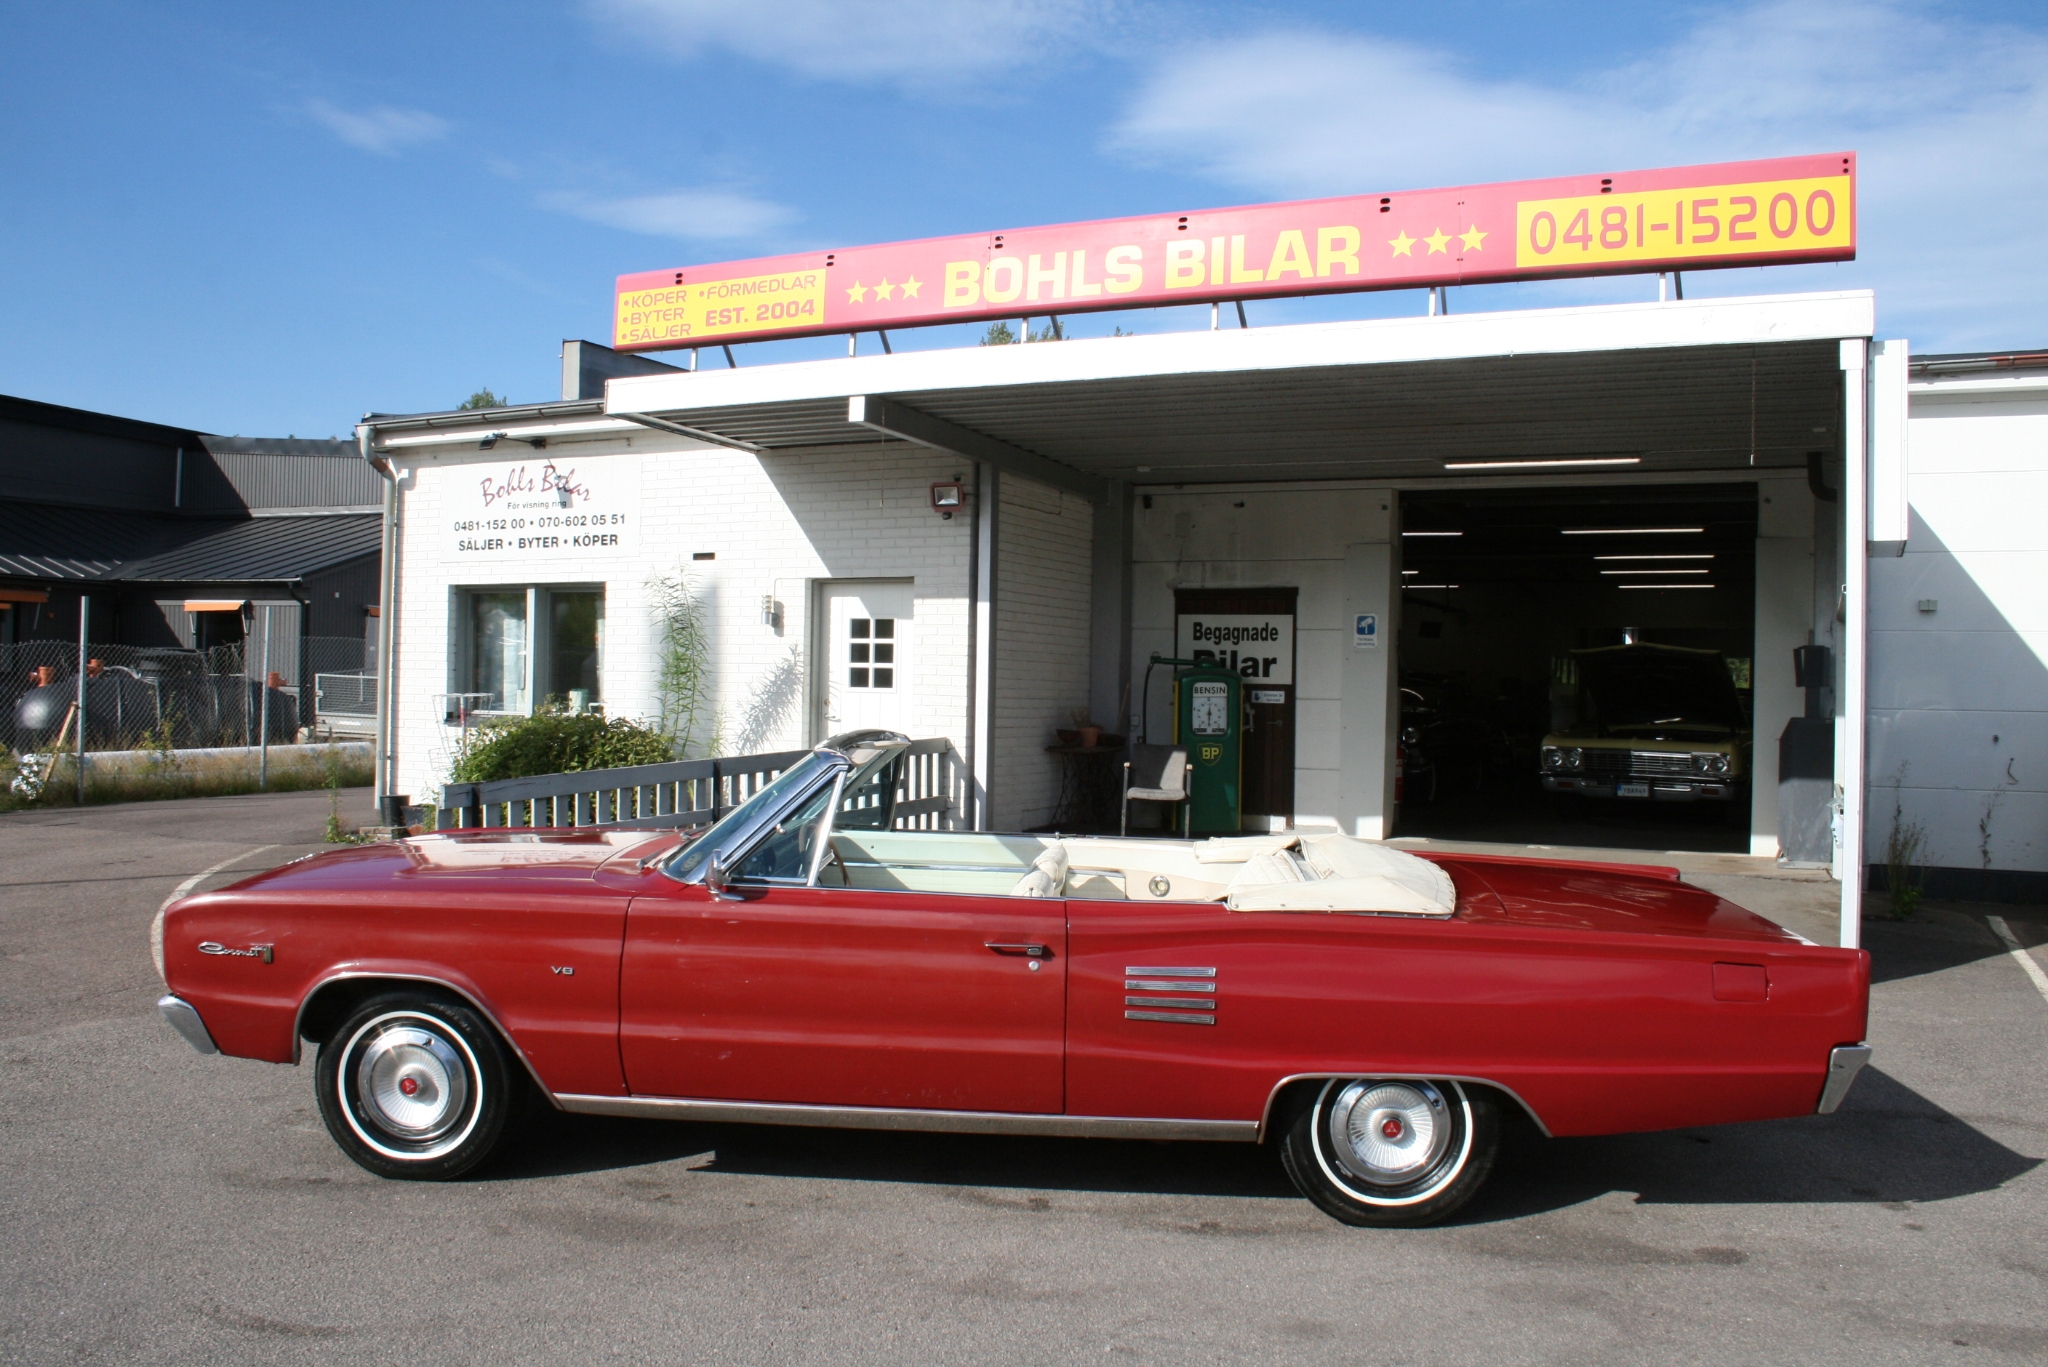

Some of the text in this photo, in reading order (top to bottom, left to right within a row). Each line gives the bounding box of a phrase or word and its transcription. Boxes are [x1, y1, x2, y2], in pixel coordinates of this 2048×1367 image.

[1530, 189, 1836, 255] 0481-15200
[943, 225, 1361, 308] BOHLS BILAR
[707, 275, 817, 300] FÖRMEDLAR
[631, 289, 688, 309] KÖPER
[630, 306, 685, 326] BYTER
[705, 298, 815, 328] EST. 2004
[629, 323, 692, 342] SÄLJER
[480, 465, 535, 507] Bohls
[507, 501, 567, 510] För visning ring
[454, 513, 626, 532] 0481-152 00 070-602 05 51
[458, 532, 619, 551] SÄLJER BYTER KÖPER
[1193, 622, 1279, 645] Begagnade
[1194, 686, 1226, 694] BENSIN
[1201, 747, 1220, 760] BP
